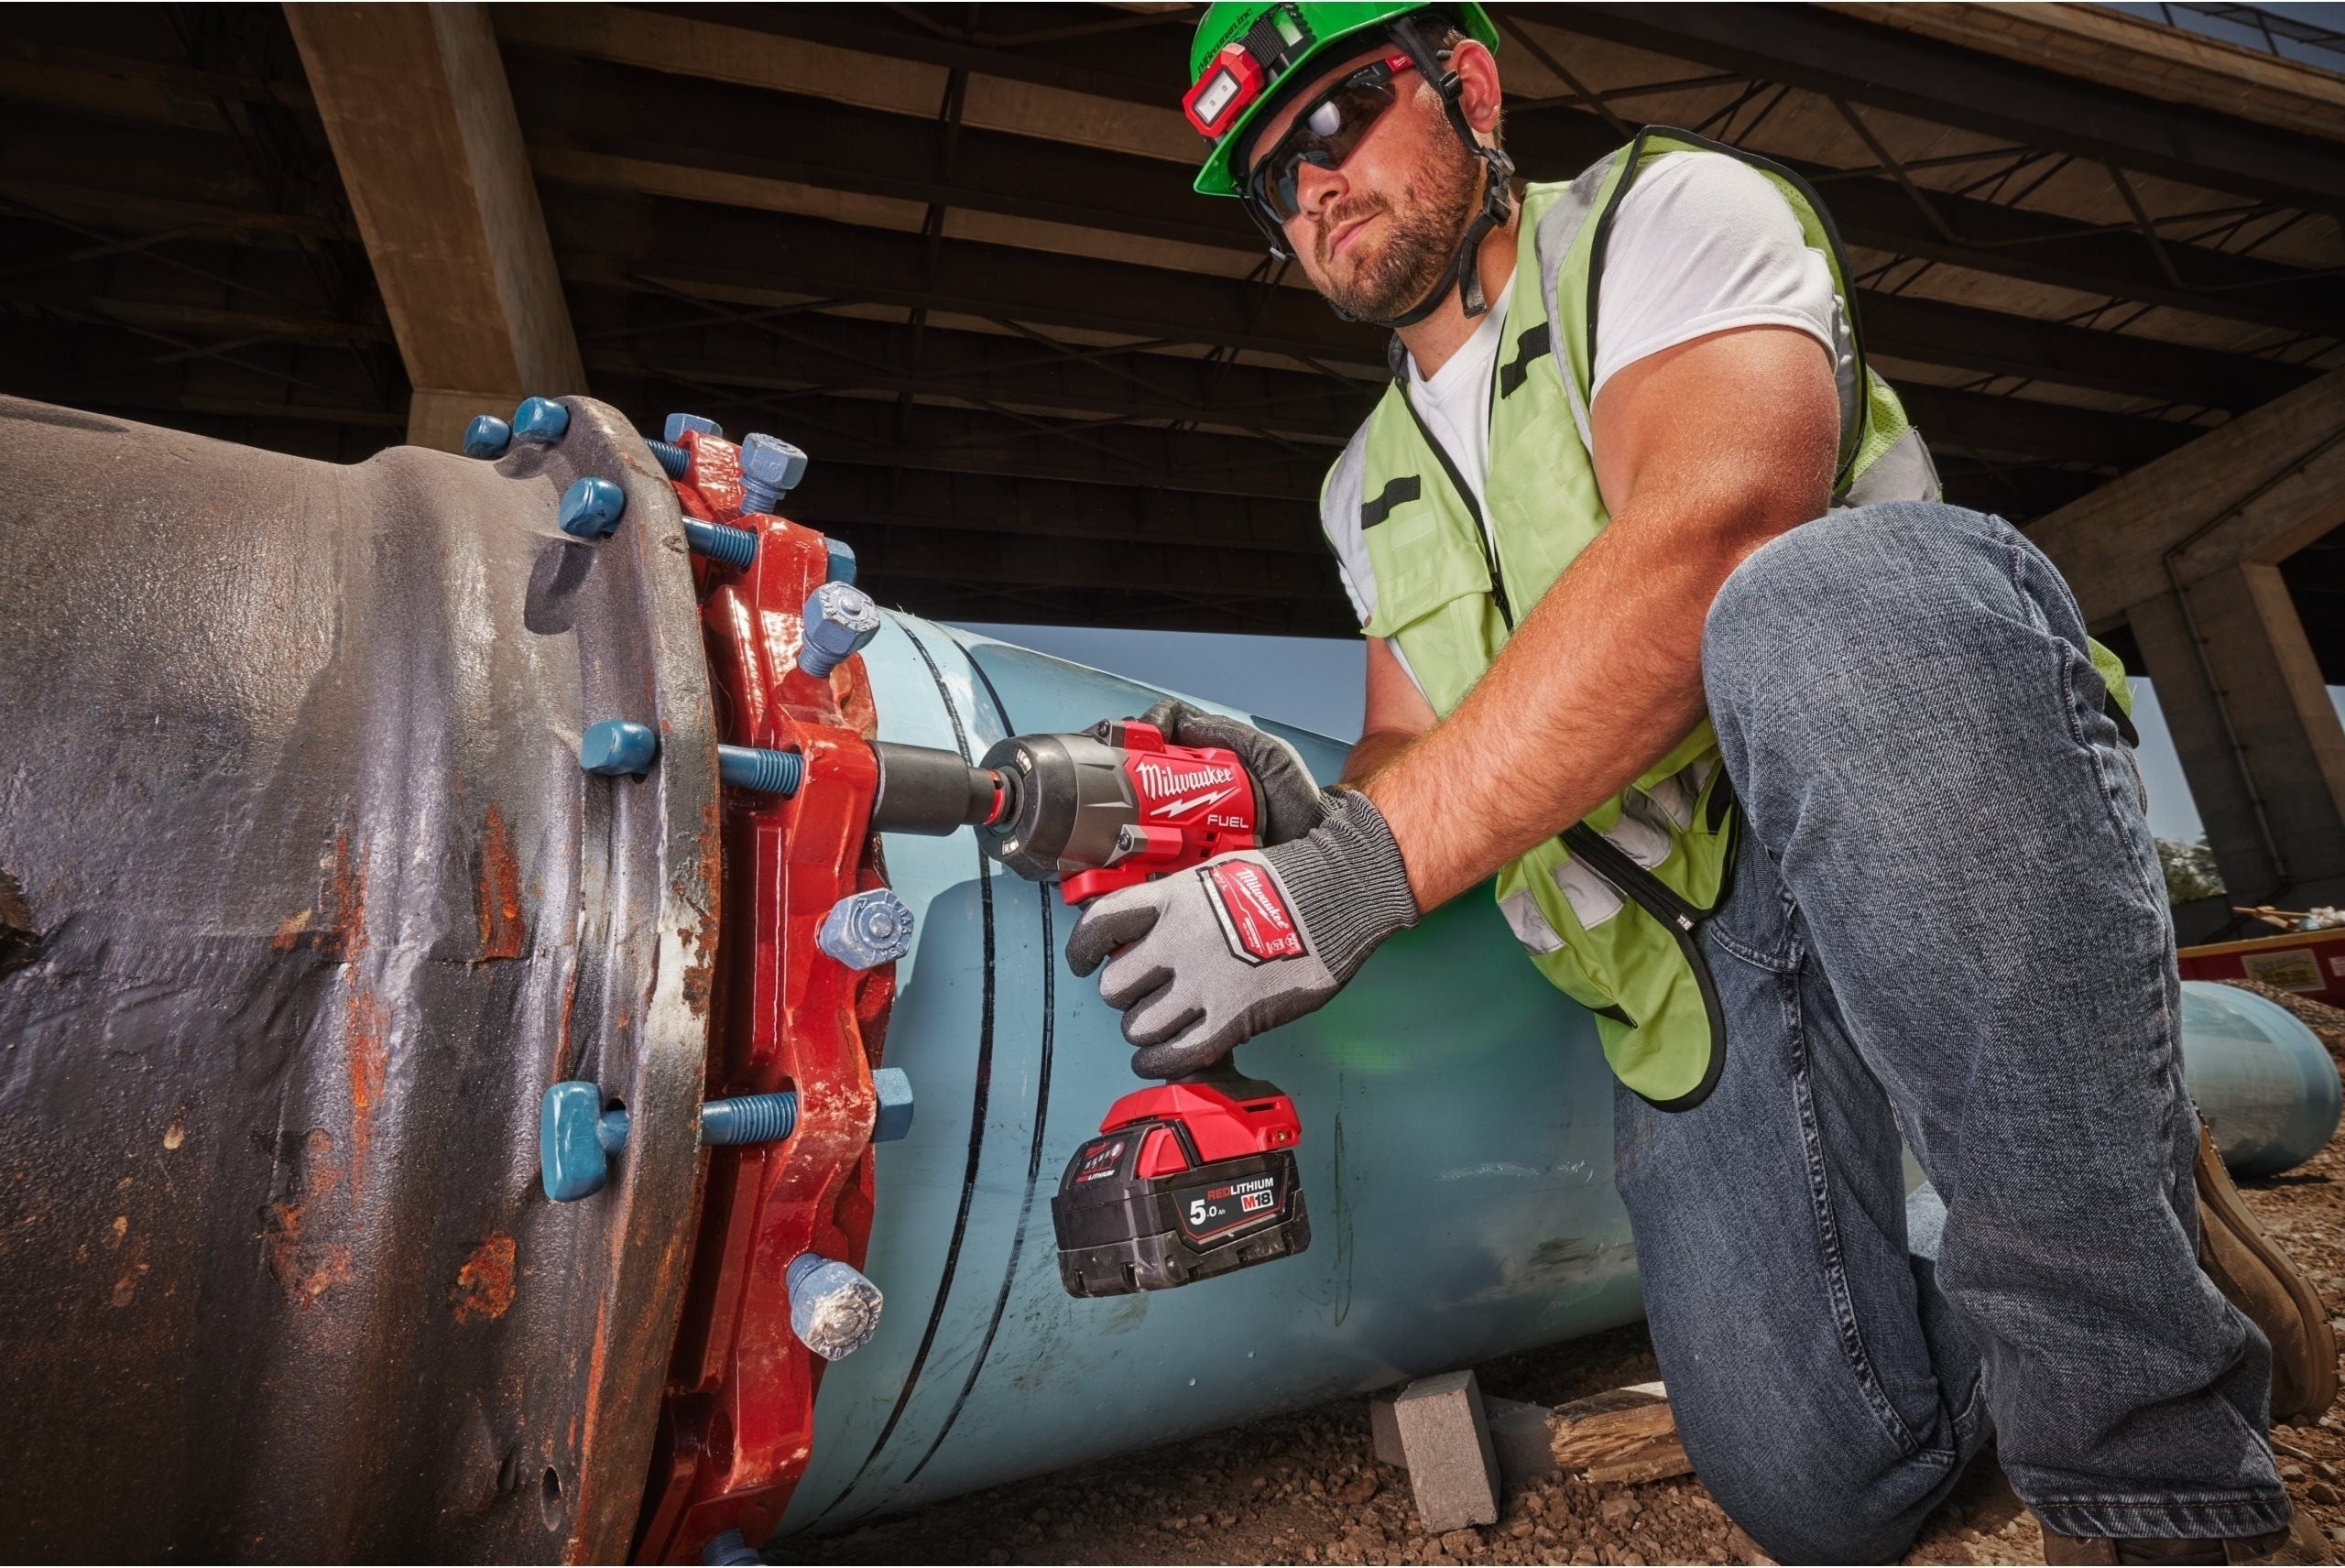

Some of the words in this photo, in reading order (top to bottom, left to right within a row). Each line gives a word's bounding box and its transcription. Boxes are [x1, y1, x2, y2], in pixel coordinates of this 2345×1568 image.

[1136, 761, 1235, 800] Milwaukee
[1207, 814, 1249, 828] FUEL
[1236, 866, 1286, 929] Milwaukee
[1216, 902, 1231, 931] LEVEL
[1242, 1192, 1271, 1210] M18
